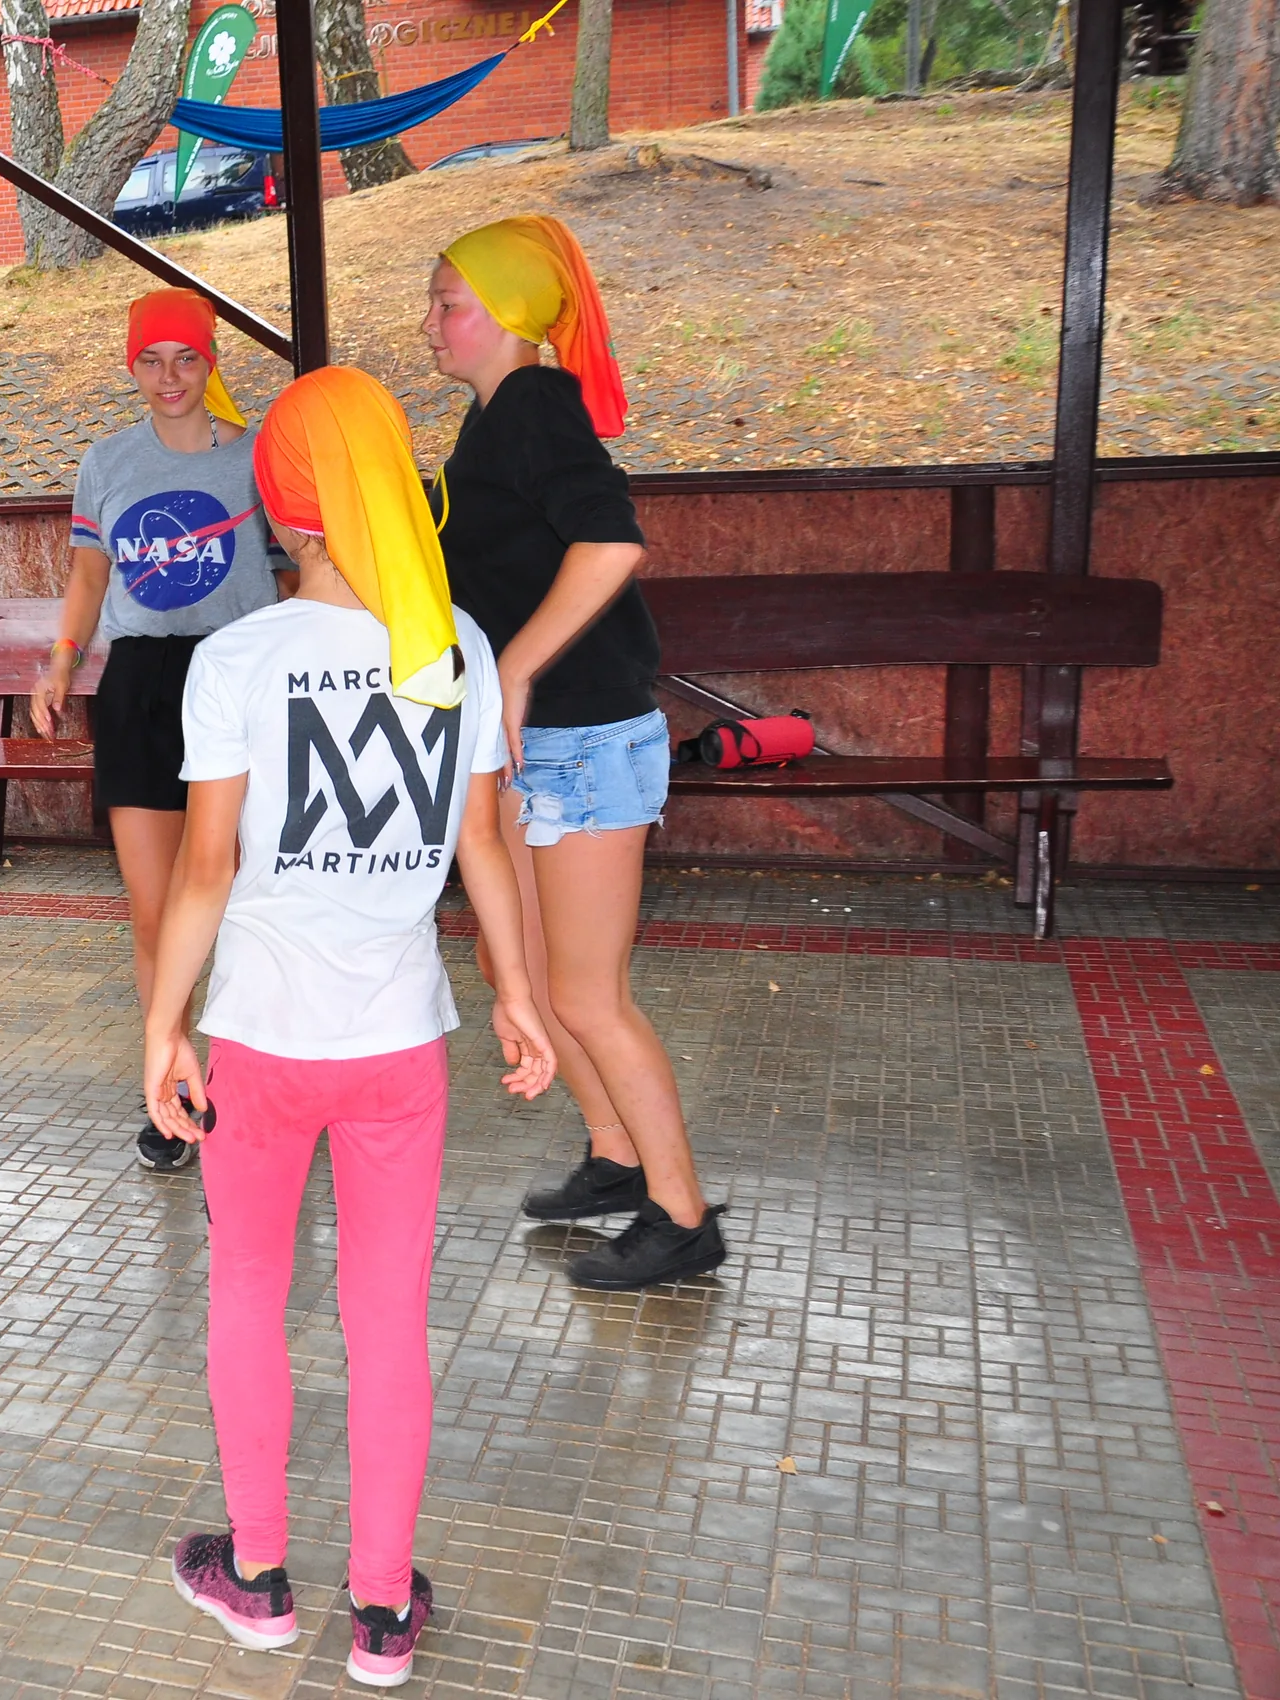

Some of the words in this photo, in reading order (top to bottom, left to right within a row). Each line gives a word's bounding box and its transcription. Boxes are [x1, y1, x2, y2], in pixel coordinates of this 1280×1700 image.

[370, 11, 531, 47] OGICZNEJ
[116, 536, 226, 565] NASA
[288, 666, 393, 694] MARC
[274, 849, 443, 875] MARTINUS
